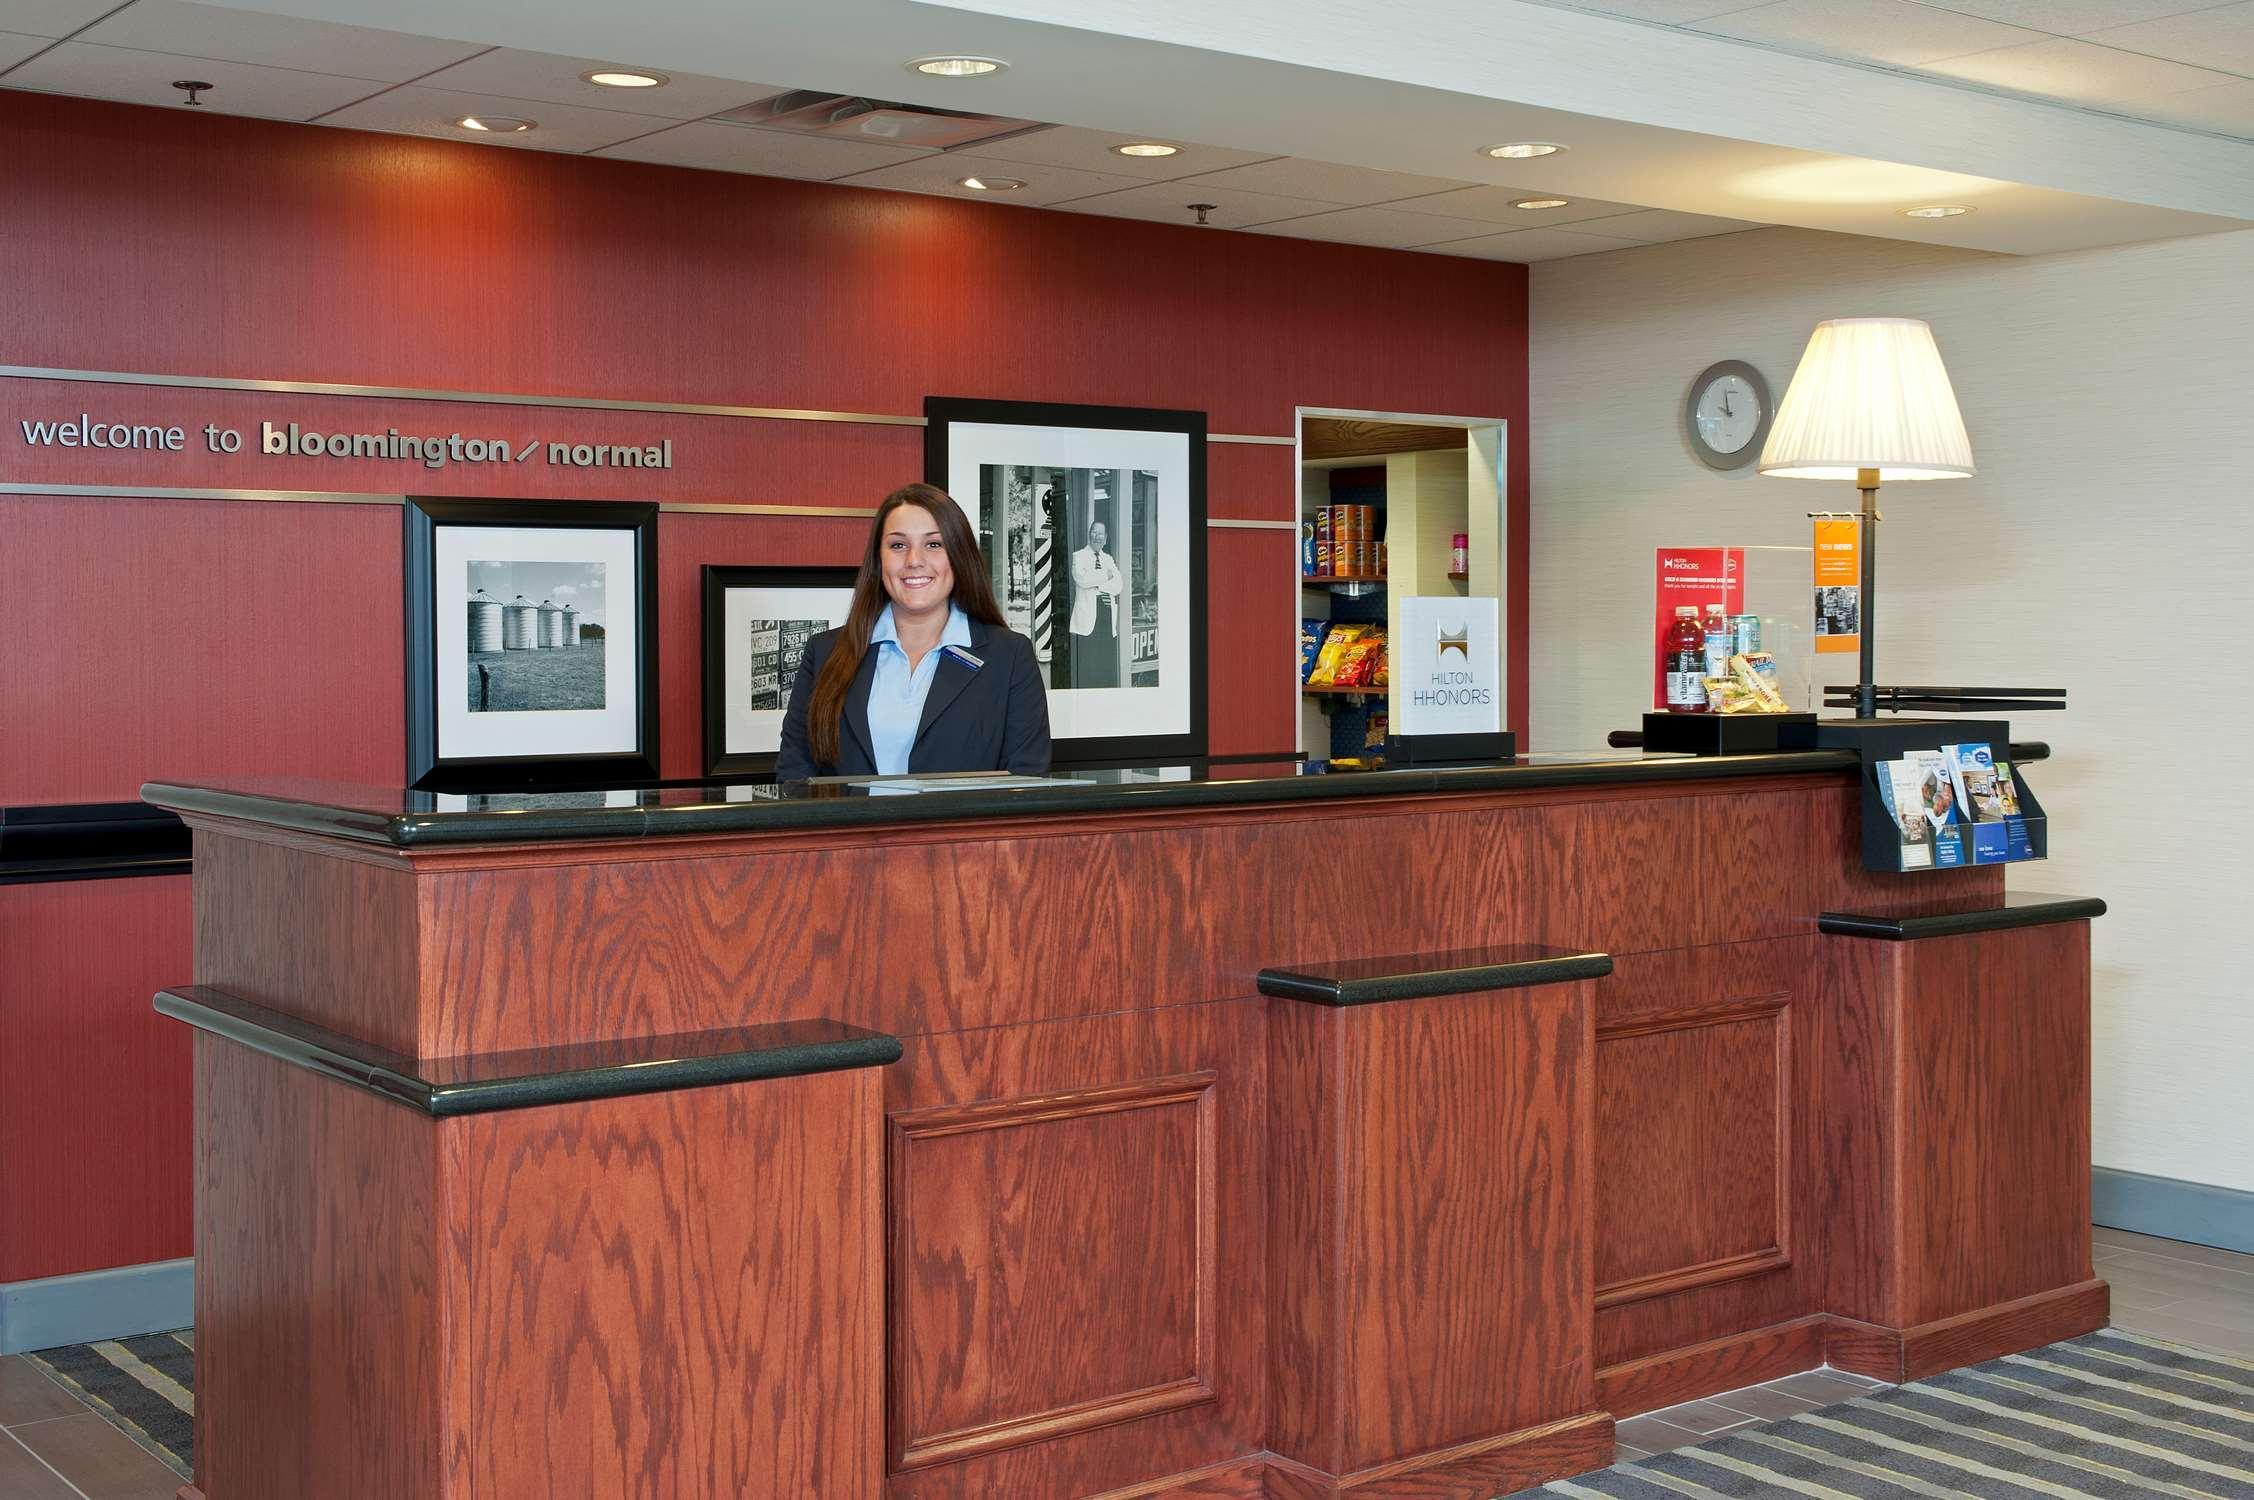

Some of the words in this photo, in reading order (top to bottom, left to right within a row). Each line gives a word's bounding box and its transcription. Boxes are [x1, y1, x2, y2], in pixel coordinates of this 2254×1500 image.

[21, 413, 185, 451] welcome
[204, 423, 243, 453] to
[260, 421, 510, 468] bloomington
[547, 439, 673, 469] normal
[1431, 672, 1473, 685] HILTON
[1414, 688, 1490, 706] HHONORS
